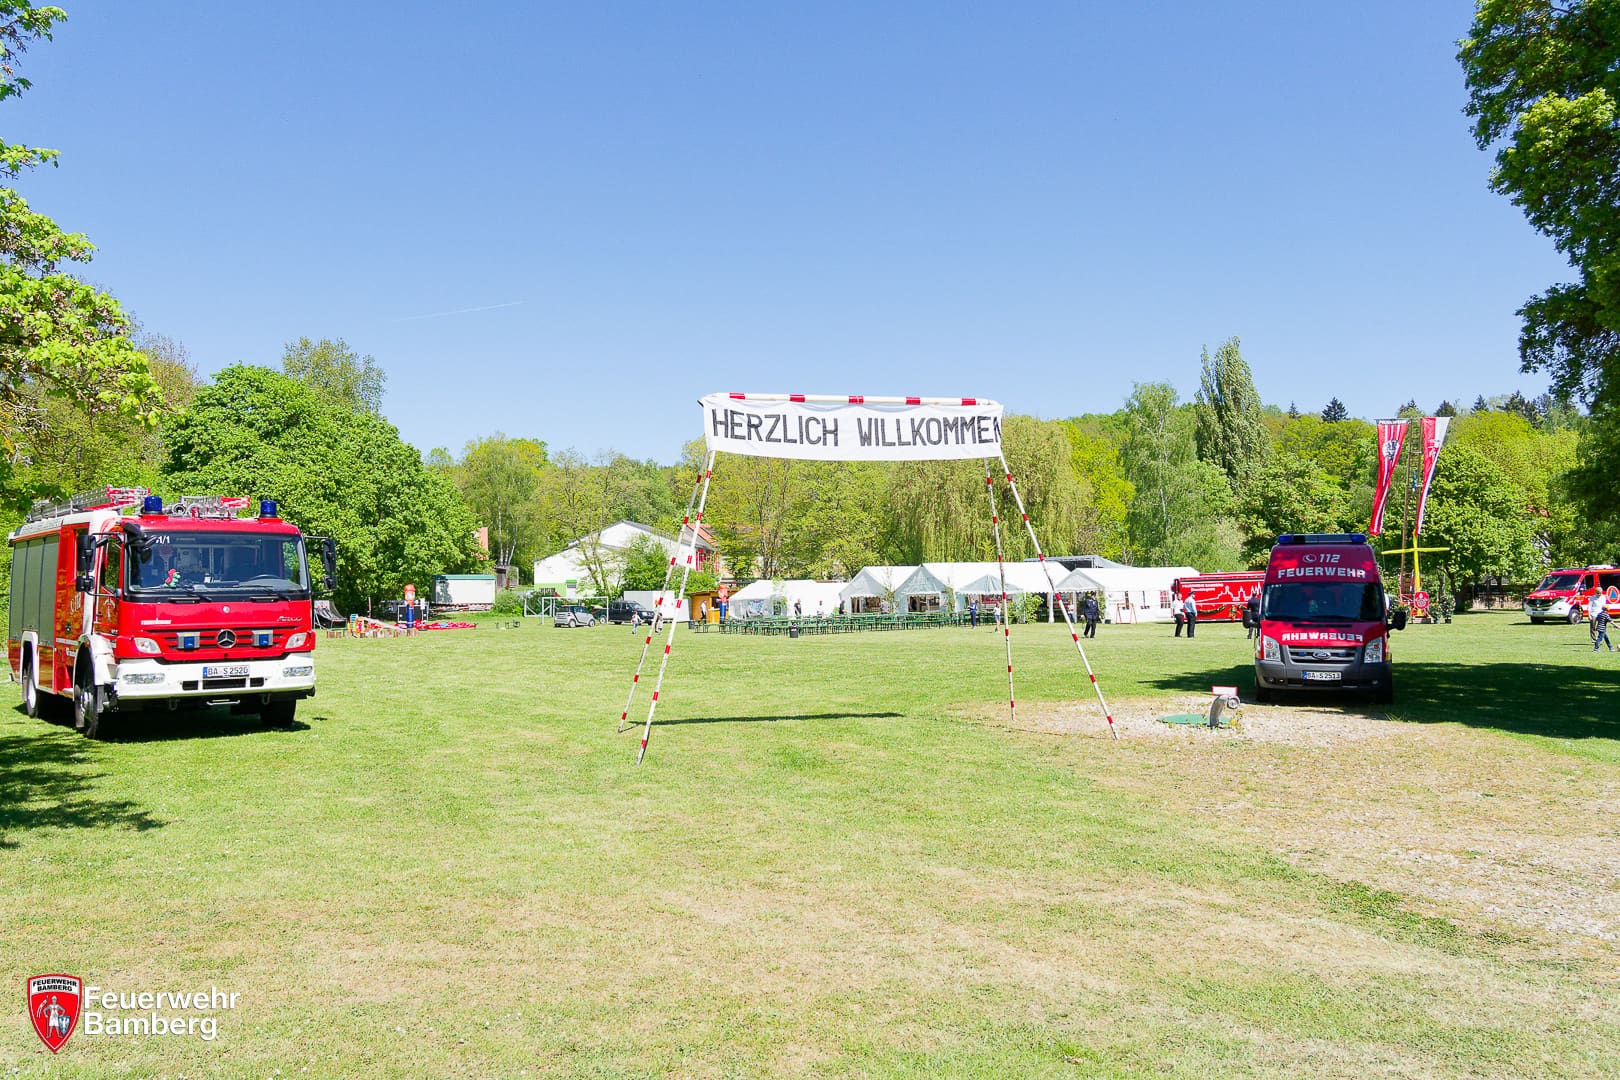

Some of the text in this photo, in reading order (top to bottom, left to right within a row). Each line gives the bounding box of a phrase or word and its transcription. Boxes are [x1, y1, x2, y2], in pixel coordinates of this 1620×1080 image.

[712, 409, 838, 447] HERZLICH
[1319, 554, 1341, 563] 112
[1278, 567, 1366, 578] FEUERWEHR
